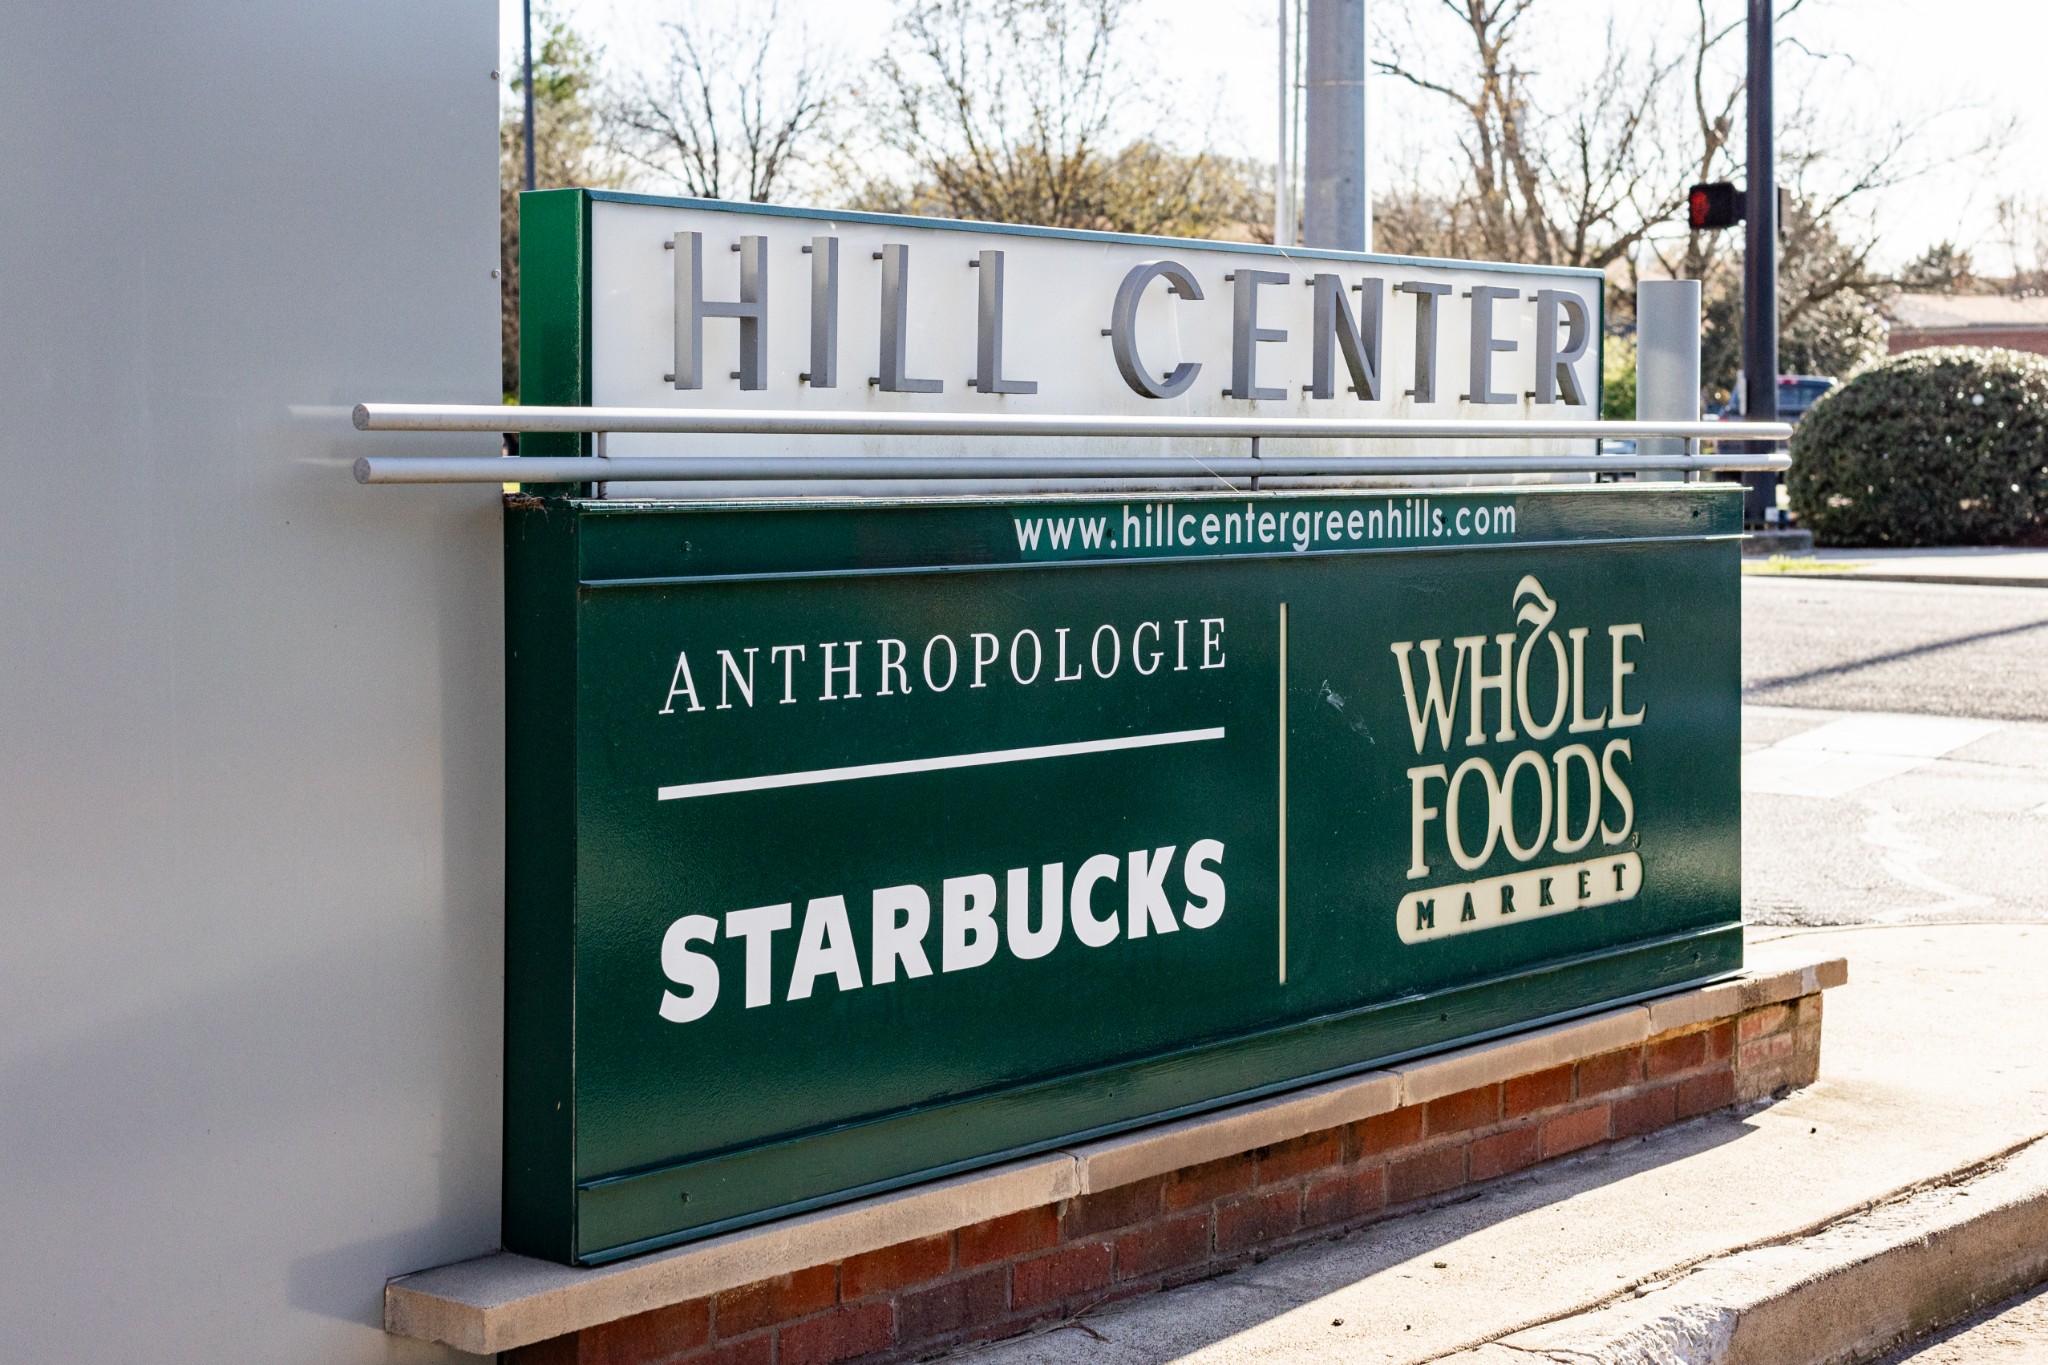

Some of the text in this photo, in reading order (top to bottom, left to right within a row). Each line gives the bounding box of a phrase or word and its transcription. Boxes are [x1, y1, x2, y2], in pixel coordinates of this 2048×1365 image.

[672, 231, 1588, 406] HILL CENTER
[1014, 500, 1518, 553] www.hillcentergreenhills.com
[658, 617, 1226, 715] ANTHROPOLOGIE
[1390, 574, 1647, 755] WHOLE
[1406, 737, 1635, 880] FOODS
[658, 838, 1226, 1023] STARBUCKS
[1415, 863, 1627, 931] MARKET
